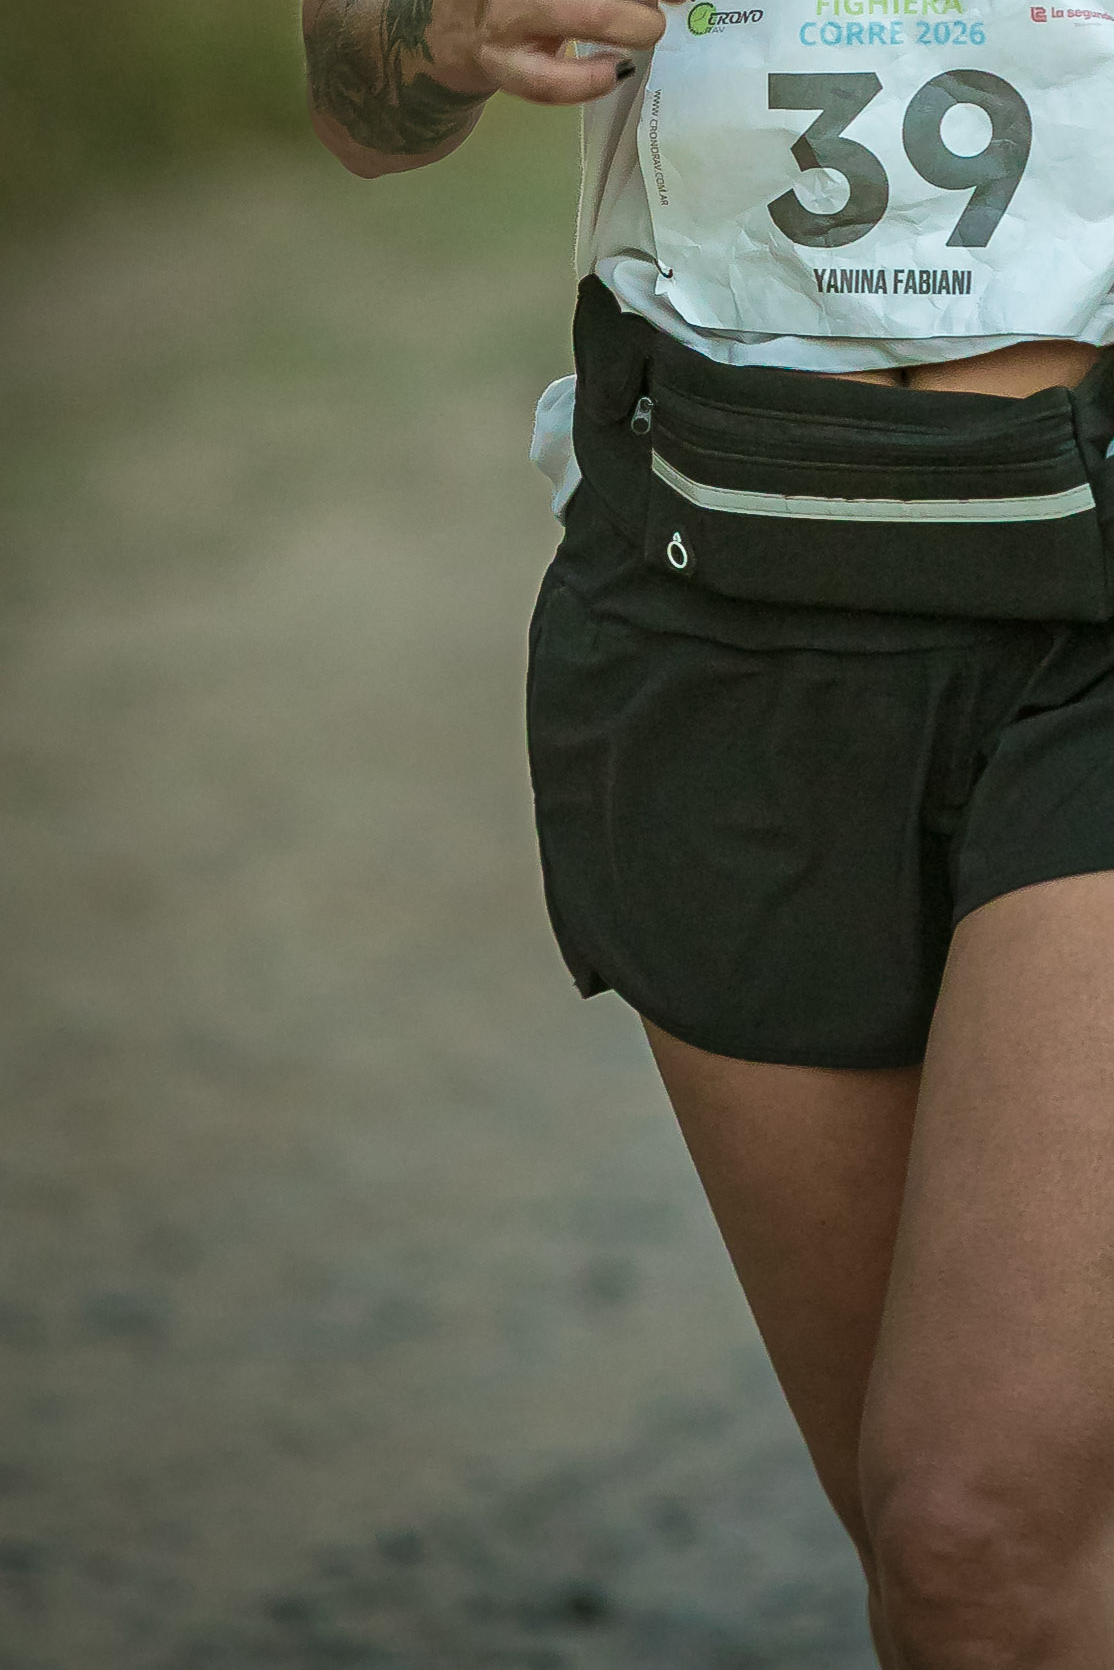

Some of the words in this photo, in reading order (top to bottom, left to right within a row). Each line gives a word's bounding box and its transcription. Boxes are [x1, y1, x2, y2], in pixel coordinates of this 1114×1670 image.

[708, 9, 764, 25] CRONO
[799, 21, 904, 46] CORRE
[916, 20, 986, 46] 2026
[767, 69, 1032, 248] 39
[813, 268, 888, 294] YANINA
[892, 269, 973, 295] FABIANI
